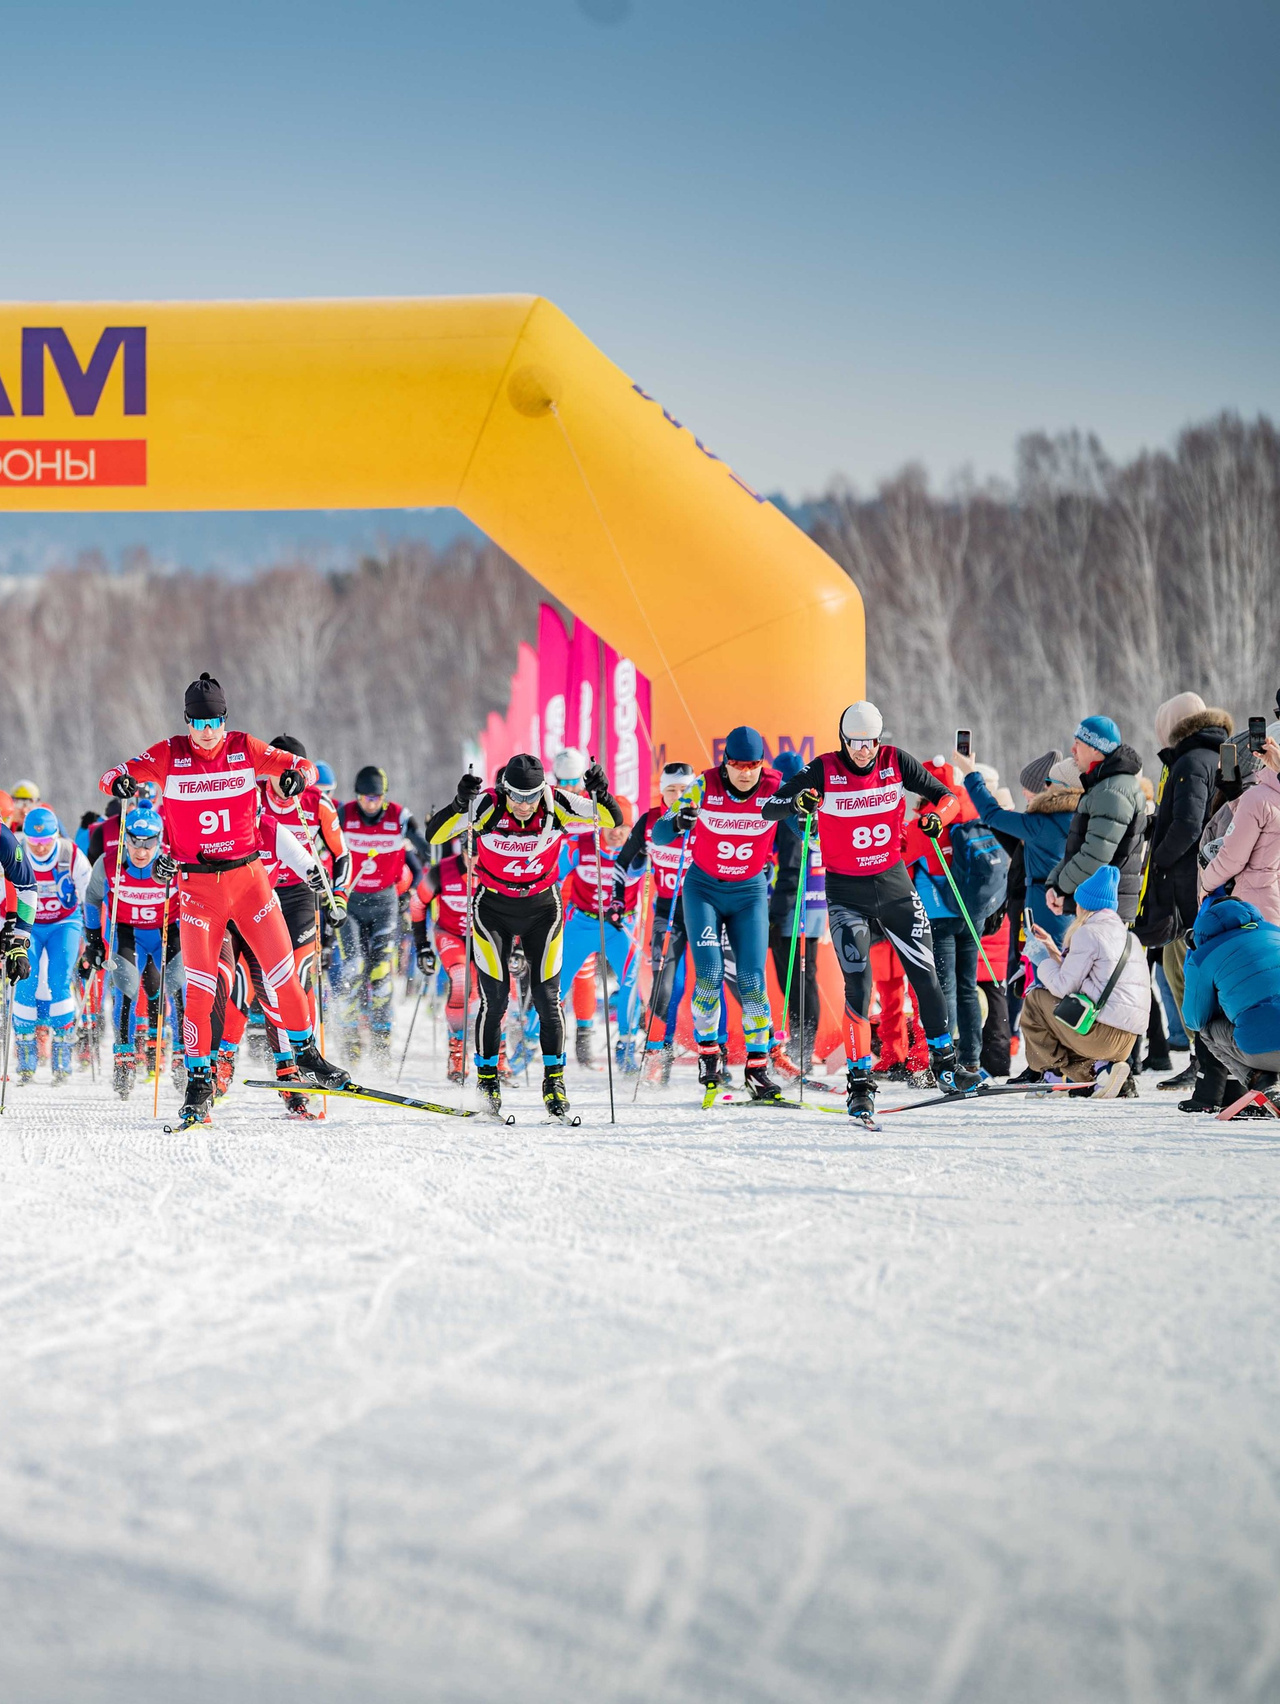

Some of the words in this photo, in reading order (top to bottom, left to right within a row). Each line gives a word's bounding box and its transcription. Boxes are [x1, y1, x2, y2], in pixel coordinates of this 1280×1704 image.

[178, 776, 245, 793] ТЕМЕРСО
[835, 790, 897, 810] ТЕМЕРСО
[198, 809, 231, 835] 91
[708, 817, 768, 830] ТЕМЕРСО
[852, 823, 892, 849] 89
[716, 841, 754, 861] 96
[503, 858, 544, 876] 44
[659, 869, 685, 890] 10
[252, 896, 277, 924] BOSCO
[910, 890, 924, 938] BLACK
[182, 912, 210, 932] LUKOIL
